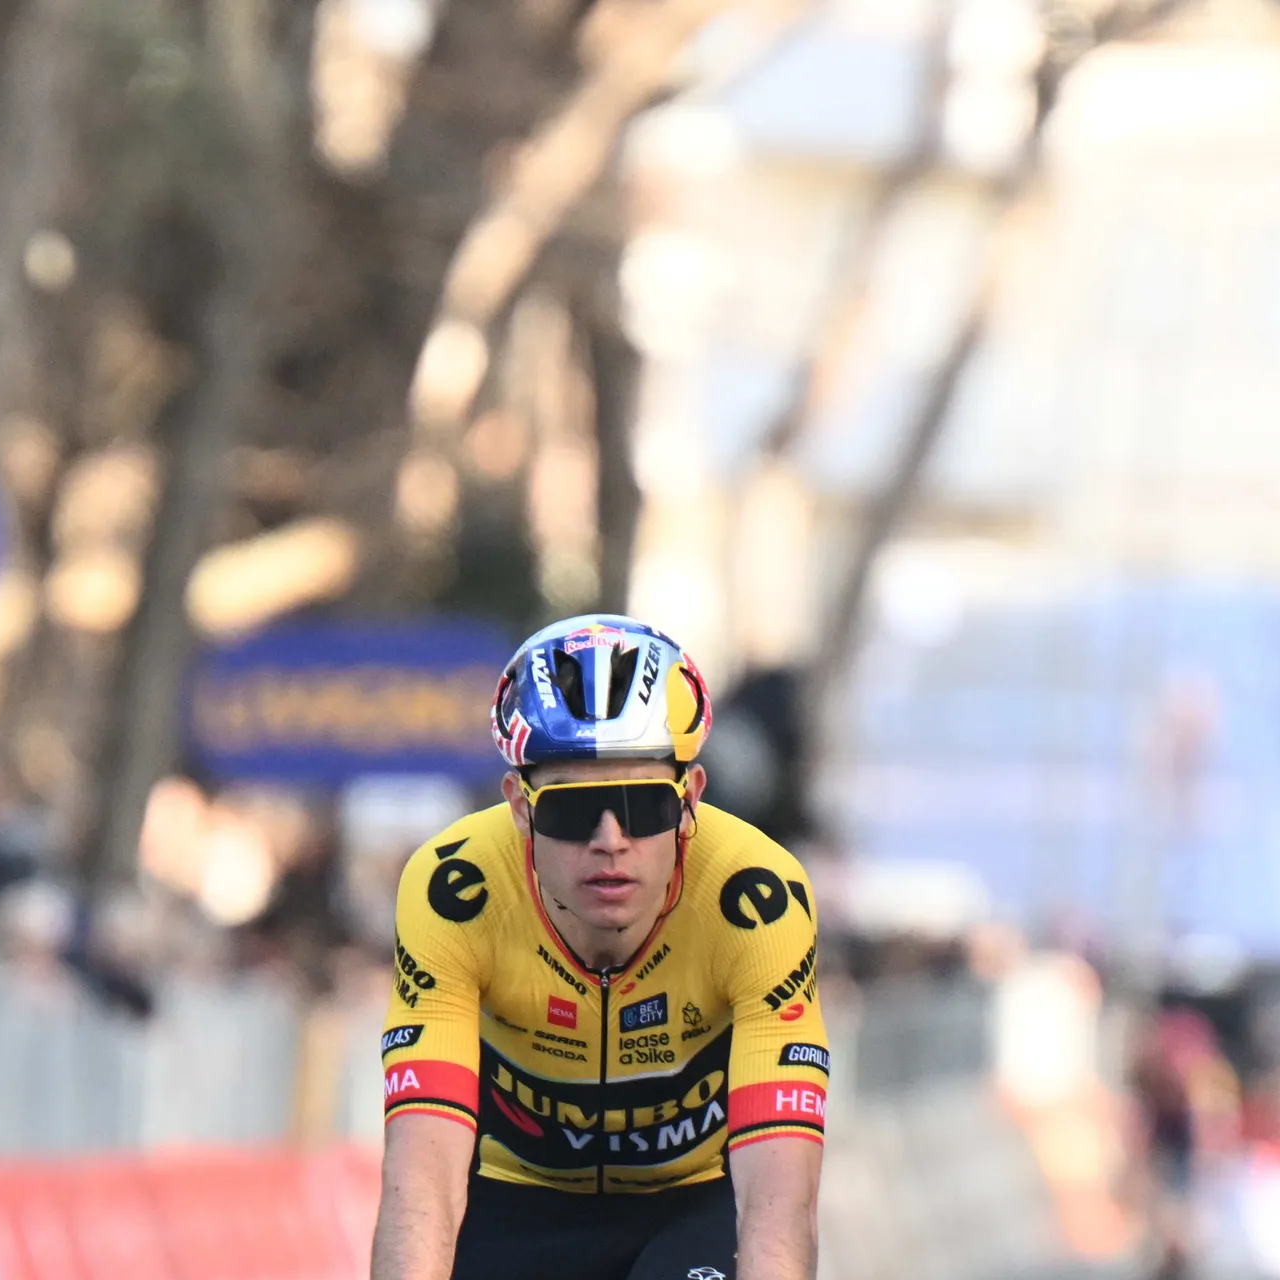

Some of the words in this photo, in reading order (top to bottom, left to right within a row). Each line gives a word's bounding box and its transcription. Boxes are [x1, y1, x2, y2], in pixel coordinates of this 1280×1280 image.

[564, 637, 596, 654] Red
[531, 648, 557, 709] LAZER
[638, 641, 662, 706] LAZER
[537, 944, 588, 996] JUMBO
[636, 944, 671, 980] VISMA
[549, 1005, 575, 1021] HEMA
[640, 1000, 660, 1013] BET
[640, 1008, 664, 1024] CITY
[534, 1030, 588, 1049] SRAM
[620, 1032, 670, 1050] lease
[620, 1052, 632, 1065] a
[636, 1049, 676, 1065] bike
[384, 1069, 420, 1099] MA
[491, 1063, 725, 1132] JUMBO
[776, 1089, 826, 1117] HEM
[562, 1100, 726, 1151] VISMA
